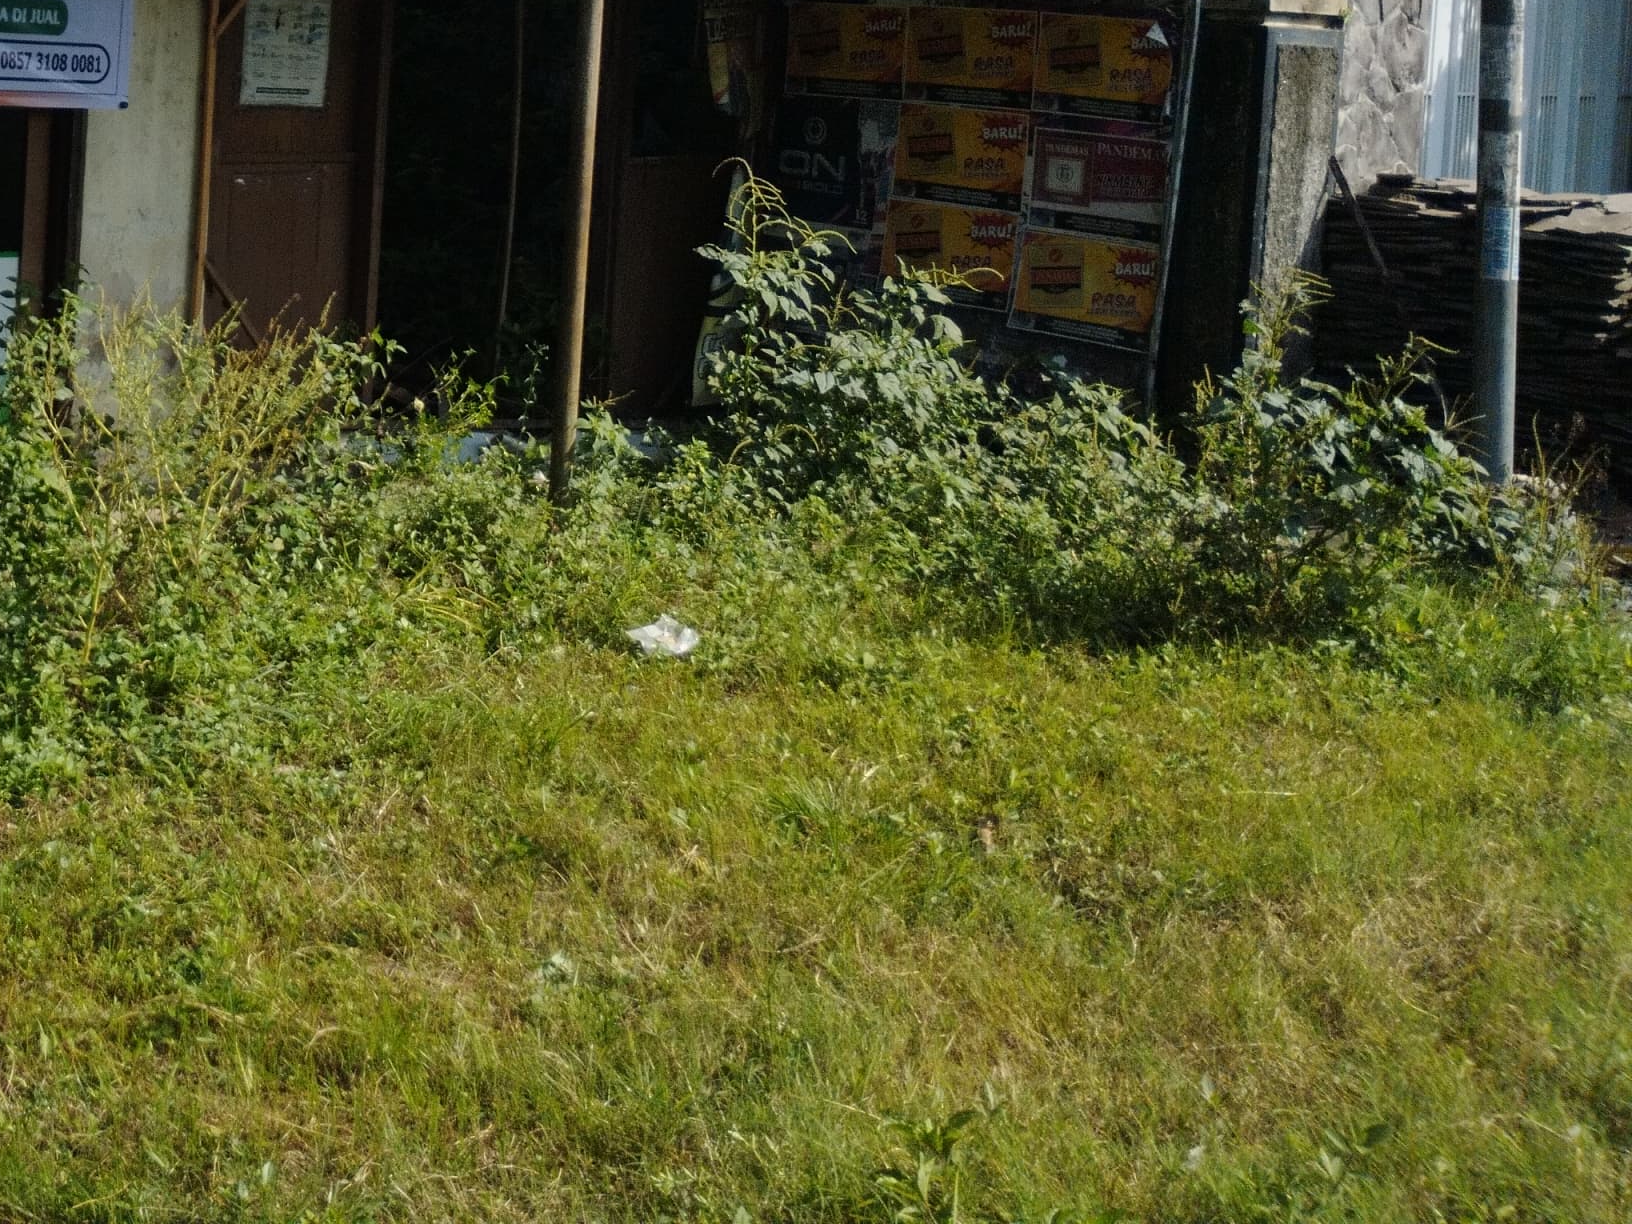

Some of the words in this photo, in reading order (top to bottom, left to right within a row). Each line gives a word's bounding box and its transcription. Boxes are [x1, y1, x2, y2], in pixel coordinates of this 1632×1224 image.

[12, 7, 27, 23] DI
[29, 8, 61, 26] JUAL
[992, 23, 1032, 38] BARU!
[1, 51, 32, 70] 0857
[36, 52, 67, 72] 3108
[71, 55, 102, 73] 0081
[982, 125, 1023, 139] BARU!
[971, 223, 1013, 237] BARU!
[1115, 261, 1155, 276] BARU!
